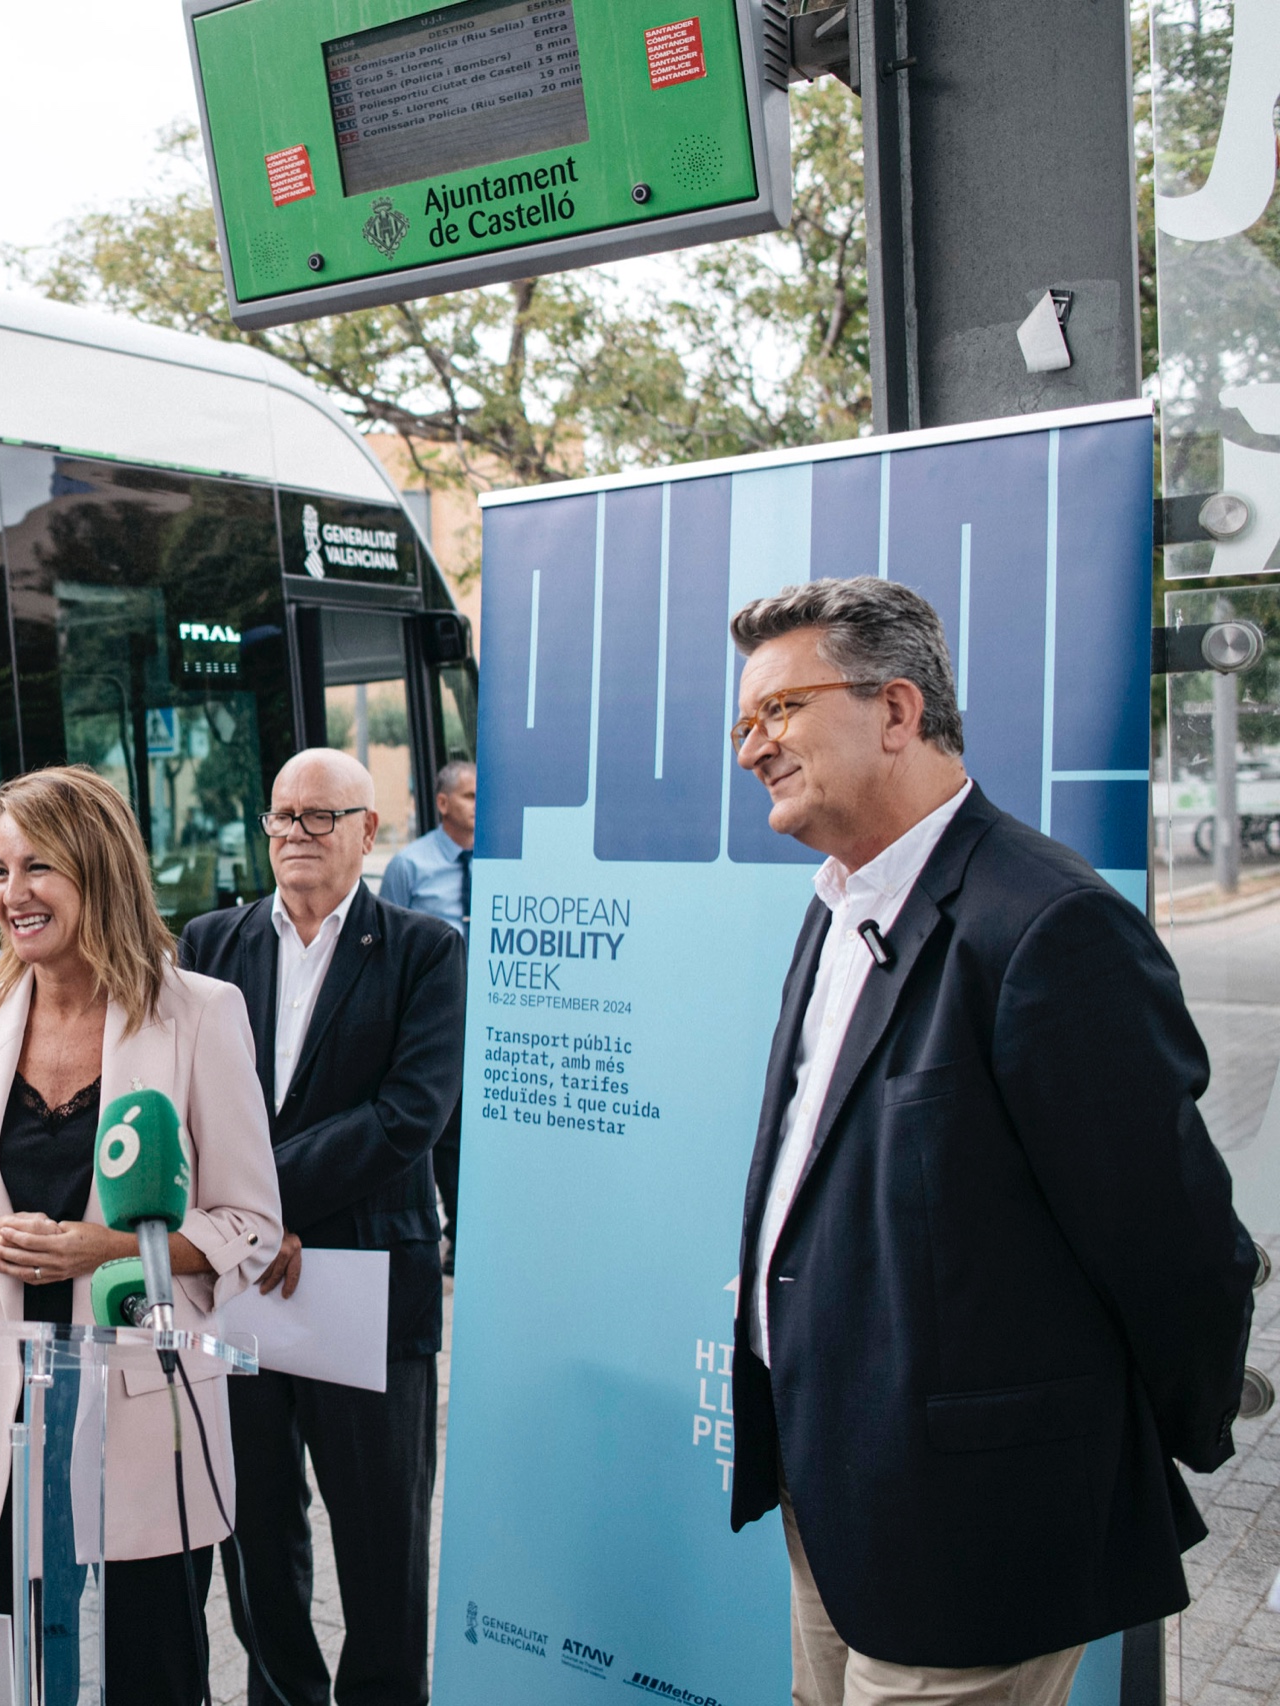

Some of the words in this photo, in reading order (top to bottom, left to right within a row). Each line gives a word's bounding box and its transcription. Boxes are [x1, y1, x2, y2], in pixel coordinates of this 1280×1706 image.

[526, 0, 569, 12] ESPER
[354, 51, 416, 73] Comissaria
[419, 39, 458, 55] Policia
[462, 31, 486, 45] (Riu
[490, 20, 524, 36] Sella)
[532, 10, 566, 24] Entra
[428, 21, 475, 39] DESTINO
[645, 20, 694, 38] SANTANDER
[328, 40, 355, 52] 11:04
[356, 74, 383, 86] Grup
[387, 70, 398, 78] S.
[401, 57, 444, 74] Llorenç
[534, 24, 568, 38] Entra
[647, 36, 696, 53] SANTANDER
[357, 84, 397, 98] Tetuan
[400, 71, 443, 89] (Policia
[454, 52, 511, 74] Bombers)
[535, 43, 543, 52] 8
[548, 37, 571, 49] min
[649, 51, 698, 69] SANTANDER
[359, 90, 428, 112] Poliesportiu
[431, 78, 468, 93] Ciutat
[471, 74, 486, 83] de
[489, 61, 531, 78] Castell
[538, 55, 553, 66] 15
[557, 49, 579, 61] min
[652, 67, 700, 84] SANTANDER
[361, 112, 389, 125] Grup
[392, 109, 403, 117] S.
[407, 97, 449, 114] Llorenç
[539, 69, 554, 79] 19
[559, 63, 581, 74] min
[363, 116, 425, 138] Comissaria
[428, 106, 467, 121] Policia
[471, 99, 495, 111] (Riu
[499, 88, 533, 104] Sella)
[541, 83, 556, 93] 20
[560, 77, 583, 88] min
[266, 146, 303, 162] SANTANDER
[268, 160, 306, 175] SANTANDER
[271, 173, 308, 188] SANTANDER
[274, 186, 311, 201] SANTANDER
[424, 156, 579, 220] Ajuntament
[429, 218, 460, 247] de
[468, 190, 575, 238] Castelló
[322, 523, 397, 551] GENERALITAT
[324, 545, 399, 571] VALENCIANA
[491, 894, 630, 927] EUROPEAN
[490, 928, 625, 961] MOBILITY
[488, 959, 561, 991] WEEK
[487, 992, 516, 1006] 16-22
[520, 994, 600, 1012] SEPTEMBER
[603, 1000, 632, 1014] 2024
[486, 1026, 570, 1049] Transport
[573, 1033, 633, 1054] públic
[485, 1047, 555, 1069] adaptat,
[561, 1055, 591, 1071] amb
[595, 1058, 625, 1074] més
[484, 1067, 554, 1089] opcions,
[560, 1073, 629, 1095] tarifes
[483, 1086, 557, 1107] reduïdes
[563, 1093, 571, 1108] i
[577, 1097, 607, 1114] que
[612, 1100, 660, 1119] cuida
[482, 1103, 508, 1121] del
[513, 1108, 541, 1125] teu
[546, 1110, 626, 1135] benestar
[482, 1615, 549, 1645] GENERALITAT
[482, 1627, 546, 1658] VALENCIANA
[562, 1638, 614, 1667] ATMV
